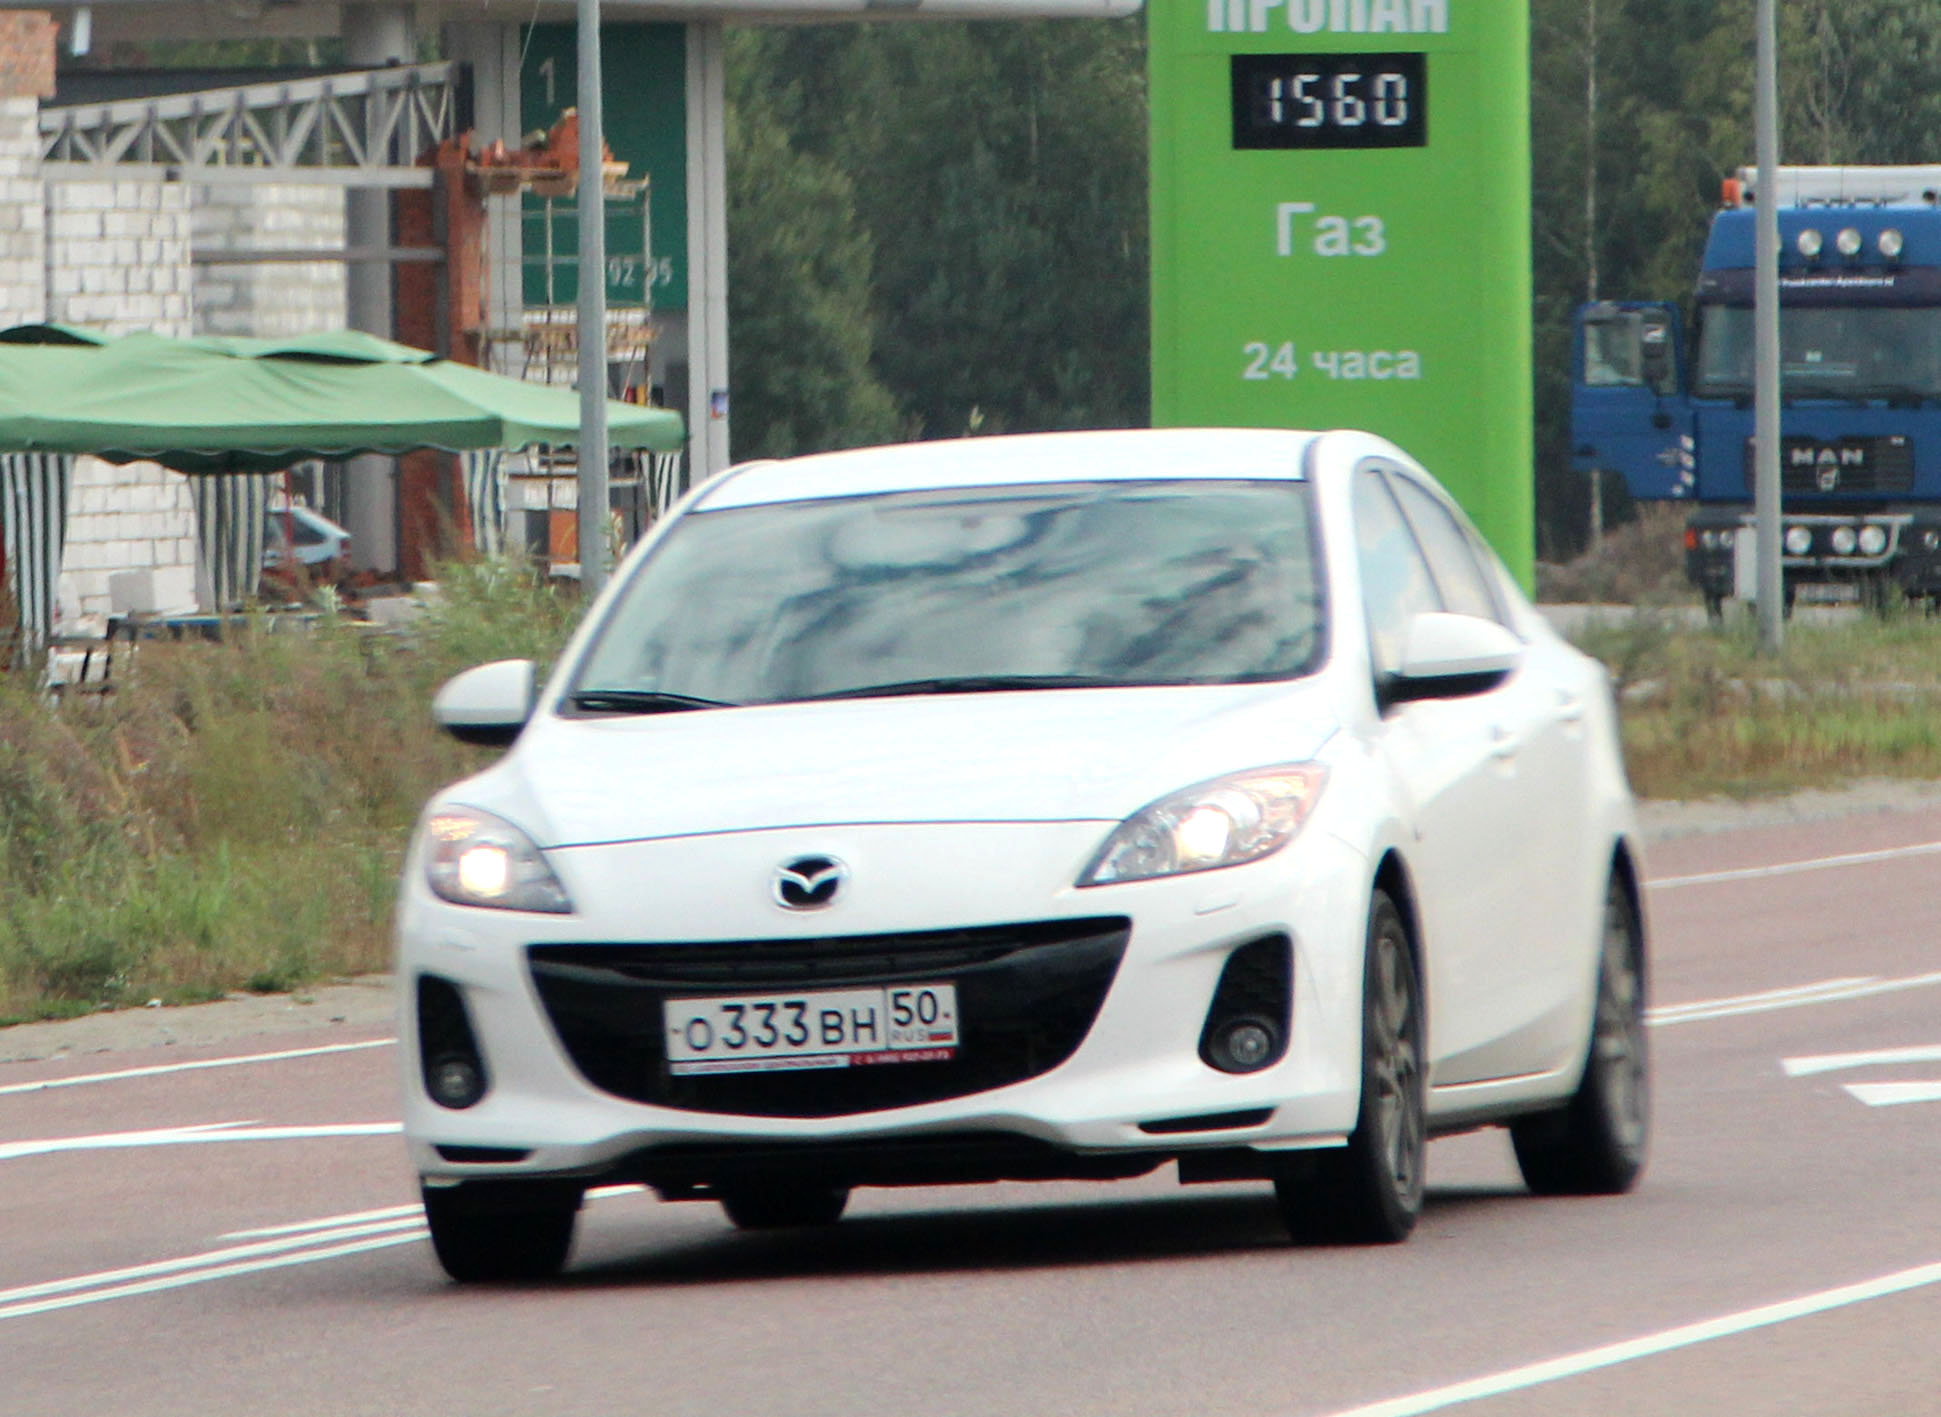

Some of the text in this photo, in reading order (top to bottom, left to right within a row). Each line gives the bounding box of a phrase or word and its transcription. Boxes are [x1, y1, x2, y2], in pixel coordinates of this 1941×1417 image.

[1269, 73, 1408, 127] 1560
[1276, 202, 1387, 257] Газ
[1243, 342, 1421, 380] 24 часа
[1792, 448, 1864, 465] MAN
[893, 991, 938, 1026] 50
